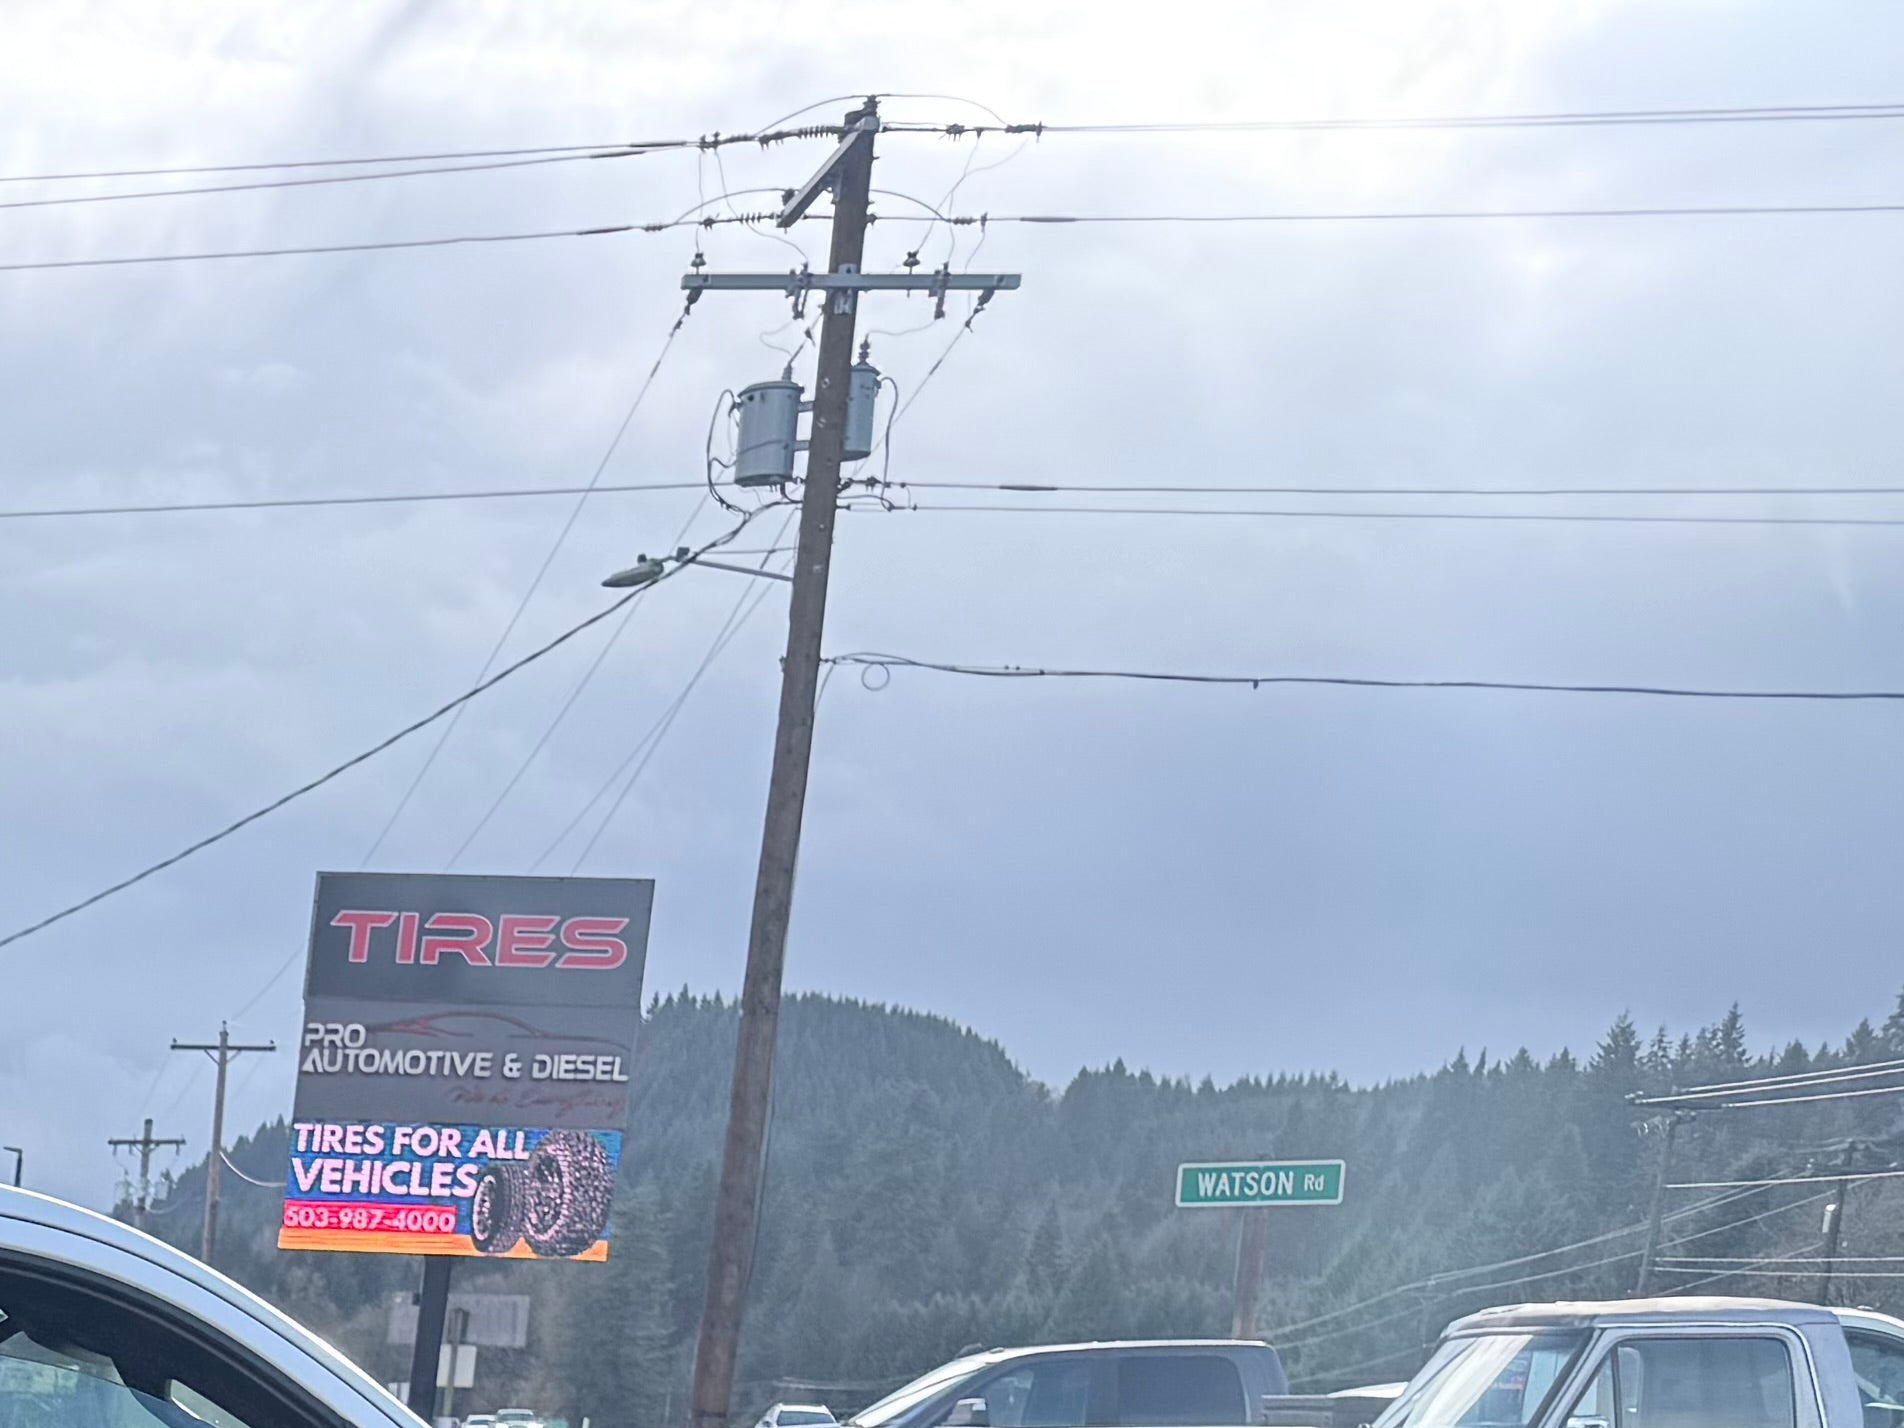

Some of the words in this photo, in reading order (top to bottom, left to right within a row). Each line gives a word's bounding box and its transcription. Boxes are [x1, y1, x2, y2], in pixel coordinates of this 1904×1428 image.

[330, 910, 630, 970] TIRES
[304, 1022, 367, 1050] PRO
[301, 1048, 493, 1078] AUTOMOTIVE
[502, 1054, 522, 1079] &
[532, 1054, 629, 1082] DIESEL
[293, 1123, 385, 1155] TIRES
[392, 1126, 462, 1158] FOR
[468, 1128, 530, 1160] ALL
[292, 1157, 479, 1198] VEHICLES
[1197, 1171, 1295, 1197] WATSON
[1304, 1174, 1325, 1191] Rd
[283, 1206, 457, 1233] 503-987-4000
